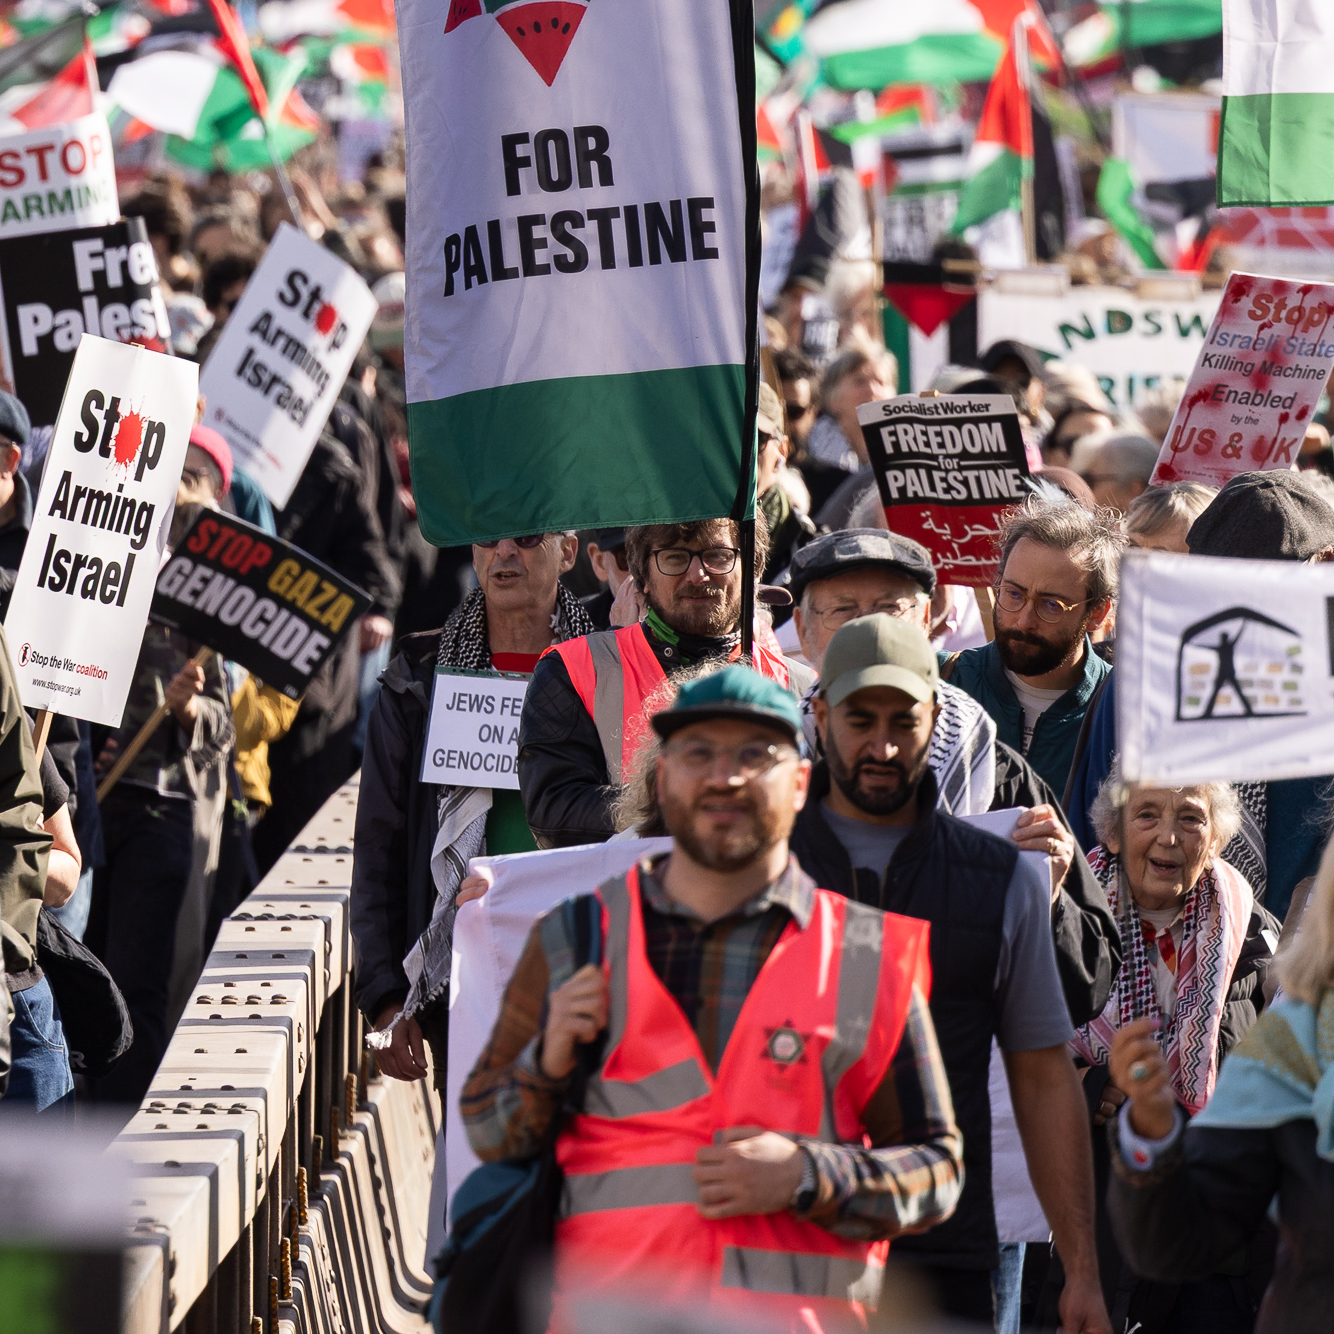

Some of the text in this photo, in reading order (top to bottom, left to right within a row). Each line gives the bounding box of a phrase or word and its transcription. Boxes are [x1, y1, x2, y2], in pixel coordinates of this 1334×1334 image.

[501, 125, 615, 197] FOR
[443, 196, 719, 297] PALESTINE
[278, 270, 348, 352] Stop
[1247, 293, 1328, 333] Stop
[249, 310, 330, 398] Arming
[1210, 327, 1280, 352] Israeli
[235, 346, 315, 428] Israel
[1201, 353, 1326, 382] Killing Machine
[882, 400, 991, 417] Socialist Worker
[1211, 384, 1297, 410] Enabled
[73, 389, 166, 482] Stop
[879, 422, 1007, 454] FREEDOM
[1230, 413, 1260, 426] by the
[938, 456, 960, 469] for
[1169, 425, 1298, 464] US & UK
[885, 468, 1027, 500] PALESTINE
[48, 470, 155, 550] Arming
[37, 533, 136, 607] Israel
[187, 518, 355, 633] STOP GAZA
[155, 556, 331, 675] GENOCIDE
[30, 651, 108, 680] Stop the War coalition
[446, 692, 523, 717] JEWS FE
[478, 724, 504, 744] ON
